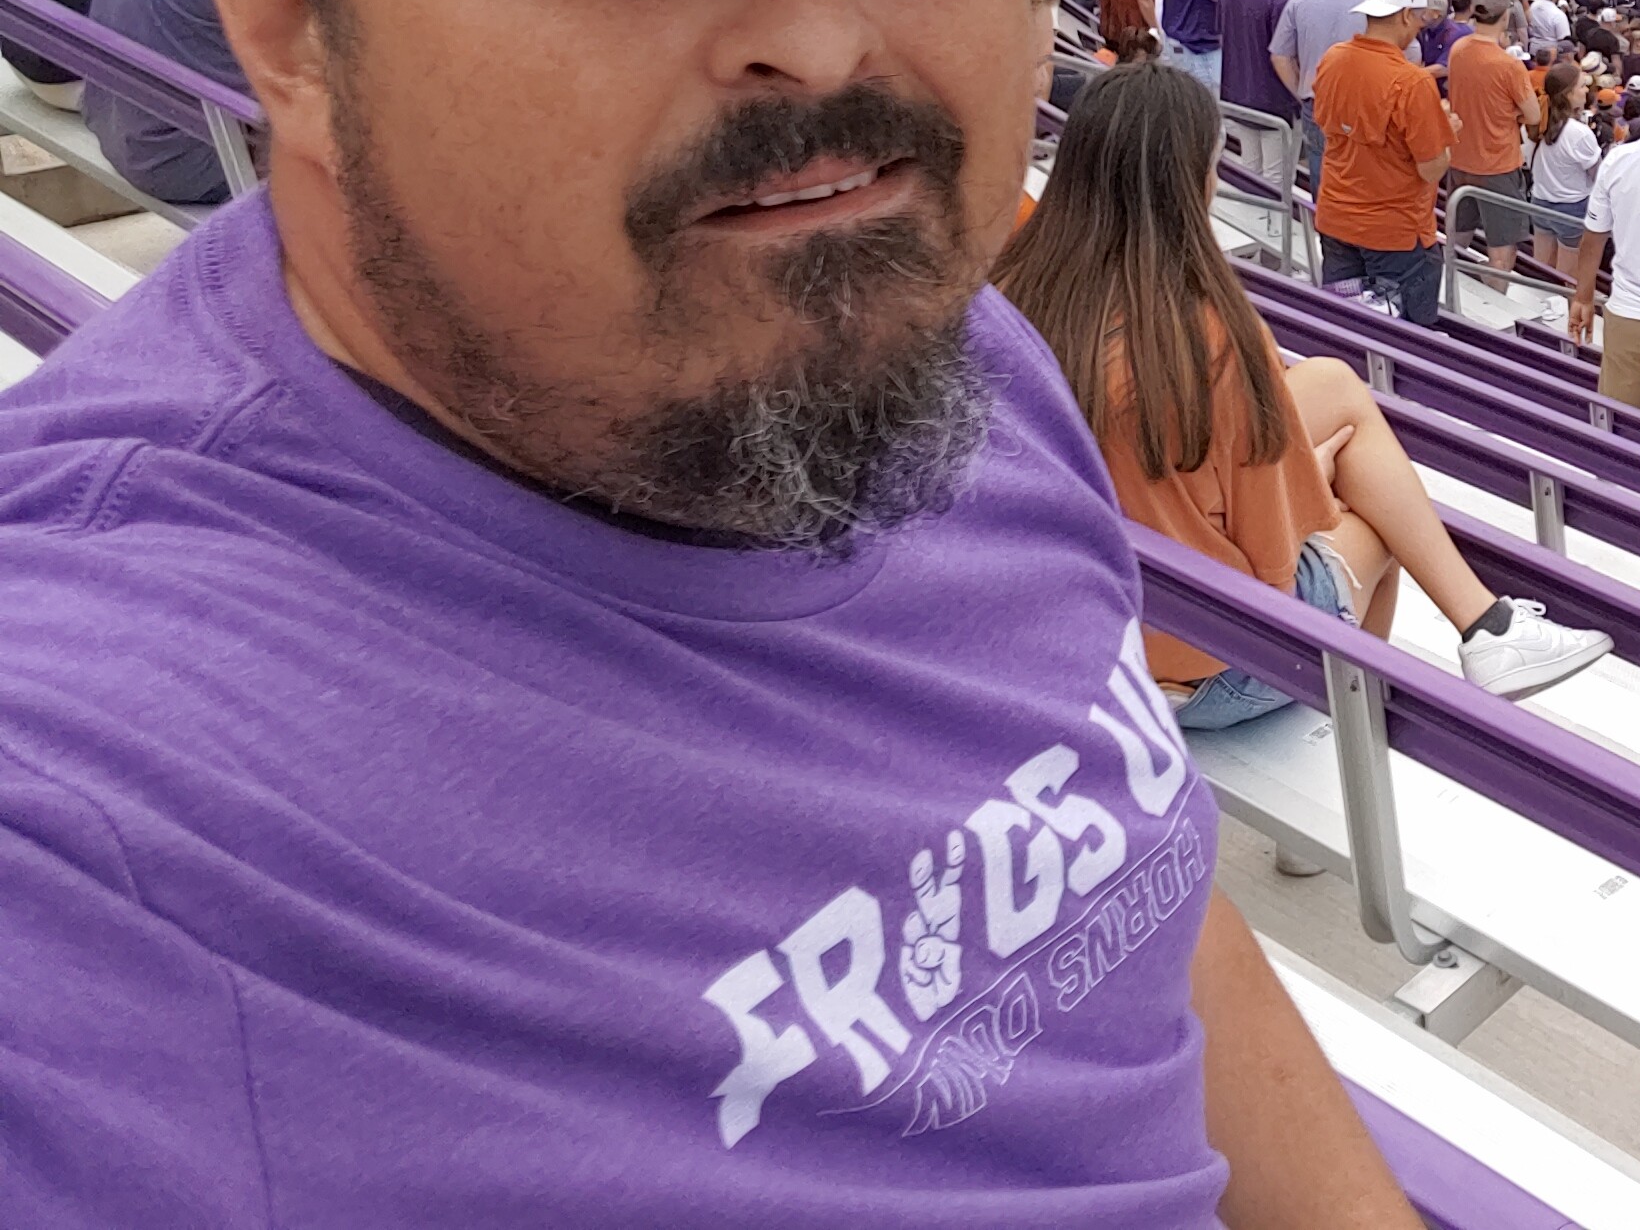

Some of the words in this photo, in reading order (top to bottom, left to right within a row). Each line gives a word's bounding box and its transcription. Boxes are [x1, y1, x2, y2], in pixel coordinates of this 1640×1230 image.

[703, 744, 1127, 1149] FRGS
[1047, 817, 1207, 1014] HORNS
[900, 972, 1043, 1138] DOWN
